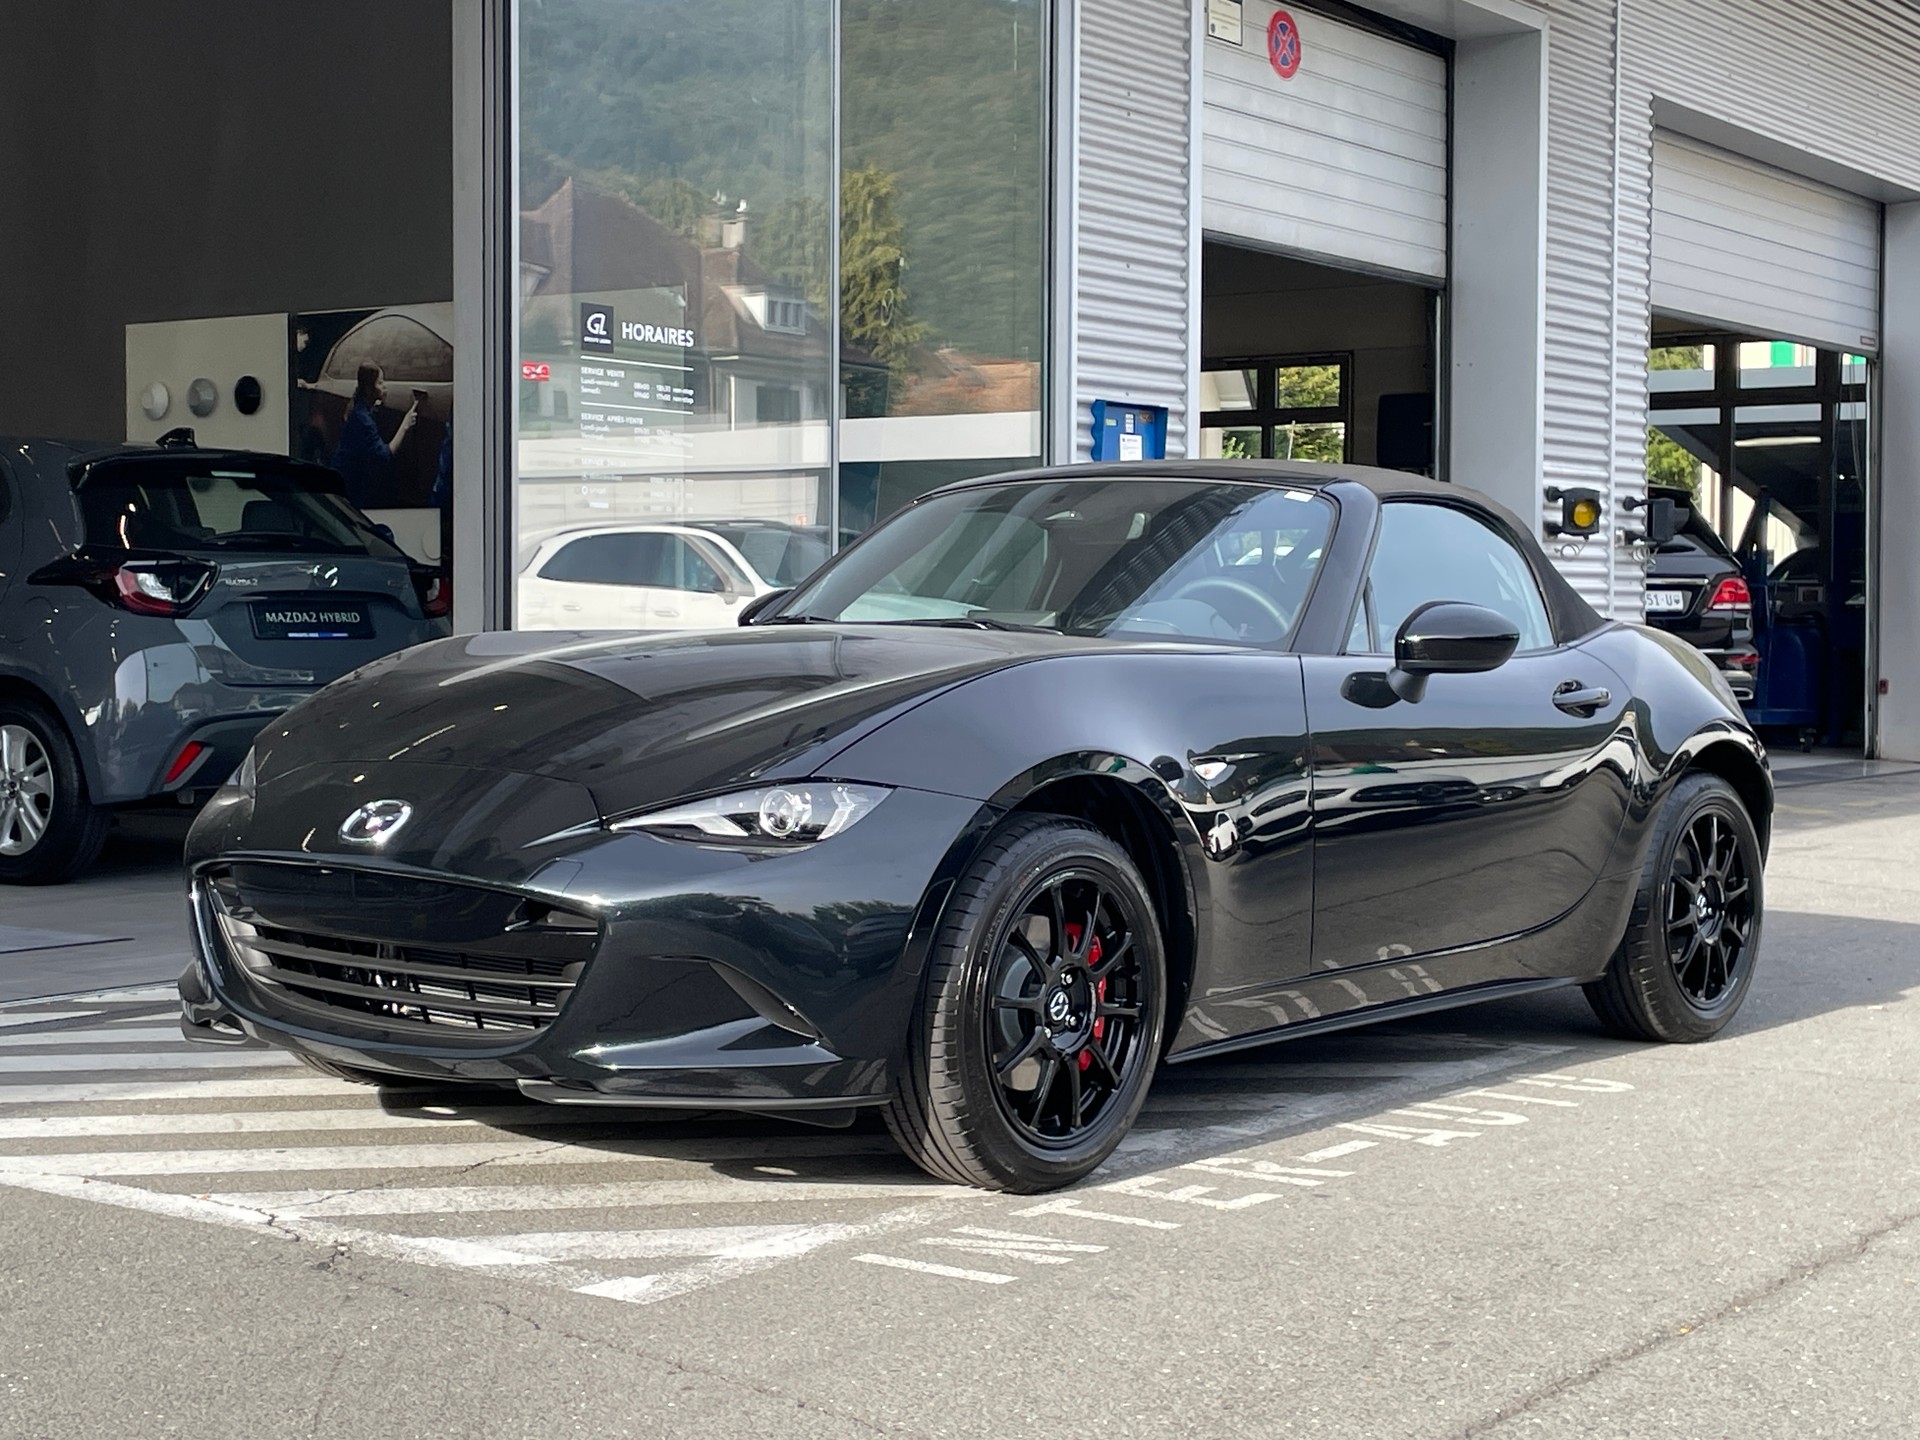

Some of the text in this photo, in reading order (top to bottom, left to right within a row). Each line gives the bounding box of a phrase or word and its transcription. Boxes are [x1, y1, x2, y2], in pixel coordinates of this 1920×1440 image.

[621, 321, 695, 348] HORAIRES
[265, 611, 361, 624] MAZDA2 HYBRID
